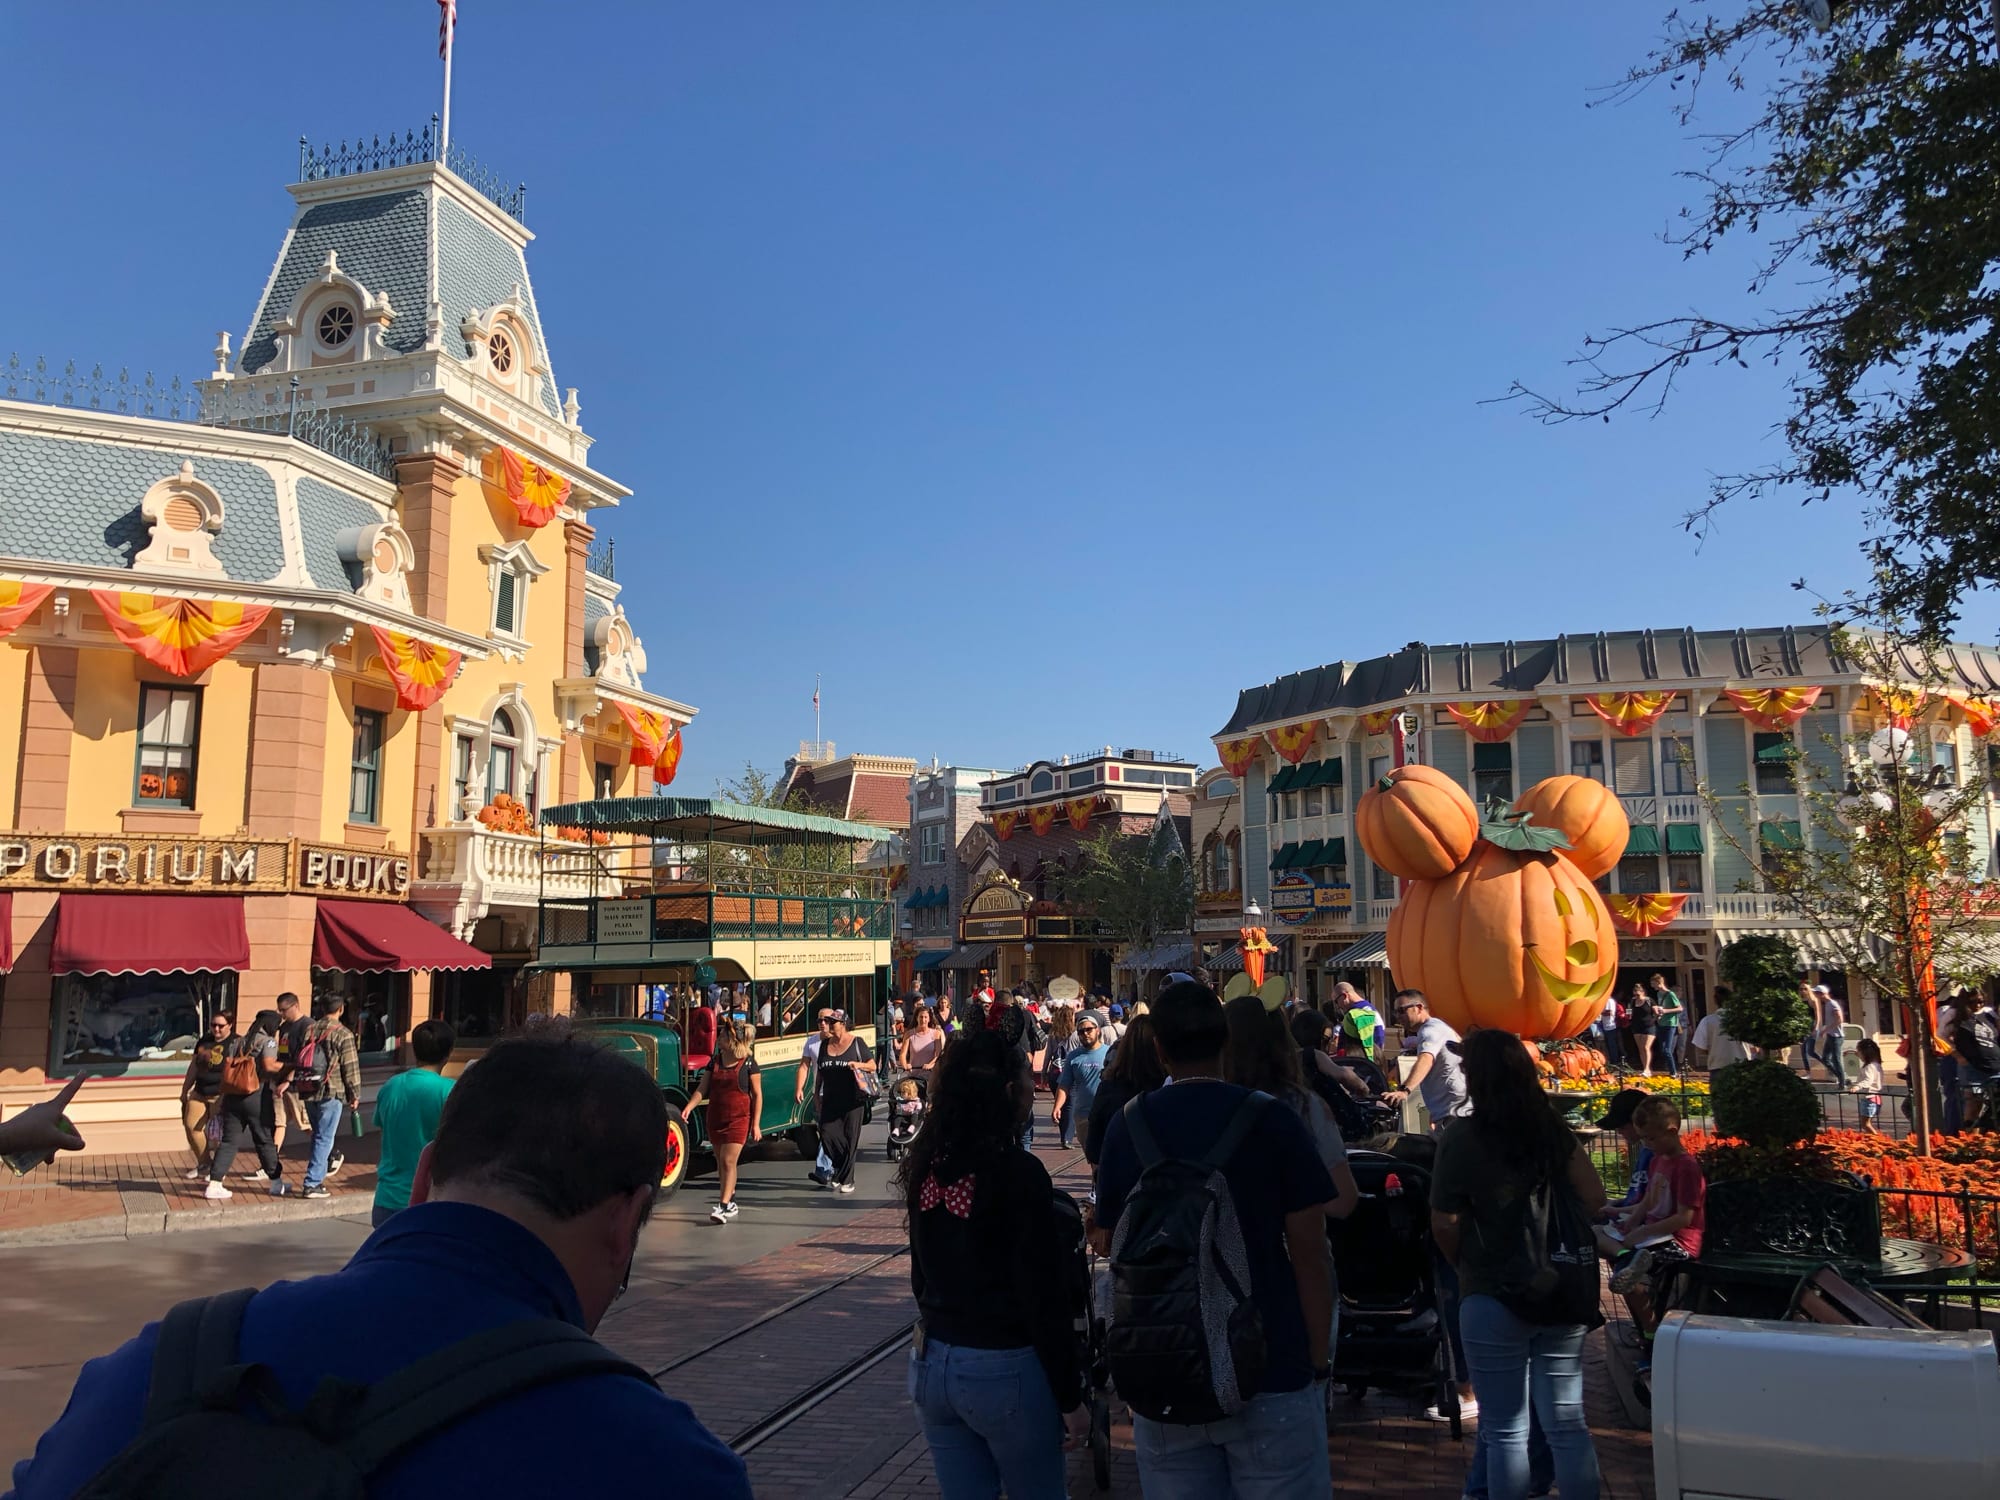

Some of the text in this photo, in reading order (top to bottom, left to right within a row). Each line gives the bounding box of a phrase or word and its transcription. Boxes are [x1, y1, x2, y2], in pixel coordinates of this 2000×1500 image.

[0, 839, 258, 882] PORIUM
[306, 849, 410, 891] BOOKS
[759, 954, 807, 965] DISNEYLAND
[808, 953, 864, 963] TRANSPORTATION
